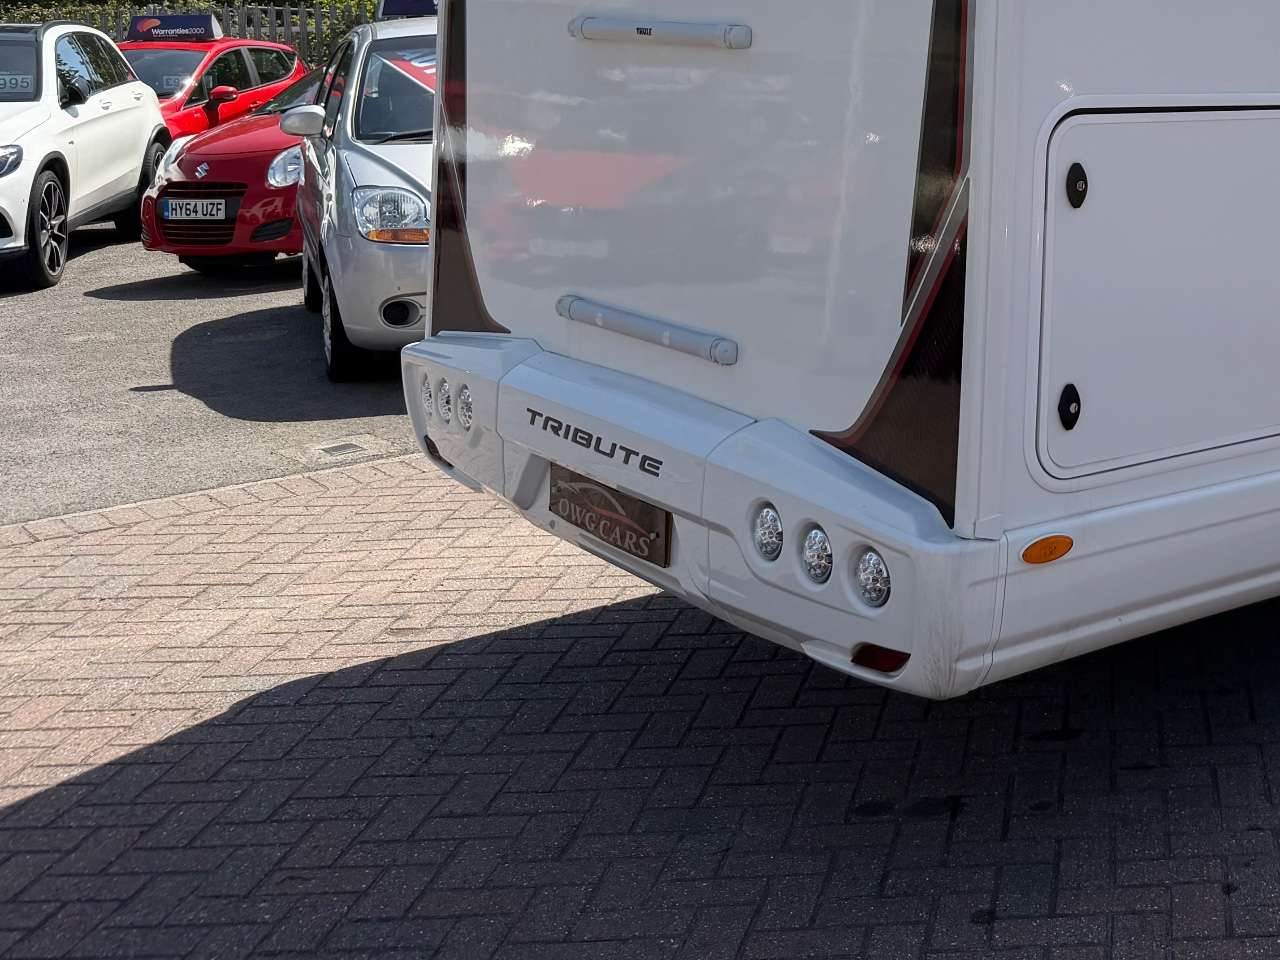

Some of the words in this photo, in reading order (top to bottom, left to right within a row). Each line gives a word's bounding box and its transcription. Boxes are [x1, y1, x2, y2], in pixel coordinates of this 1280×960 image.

[170, 202, 199, 217] HY64
[201, 202, 223, 217] UZF
[526, 407, 664, 478] TRIBUTE
[559, 498, 596, 530] OWG
[599, 520, 650, 556] CARS
